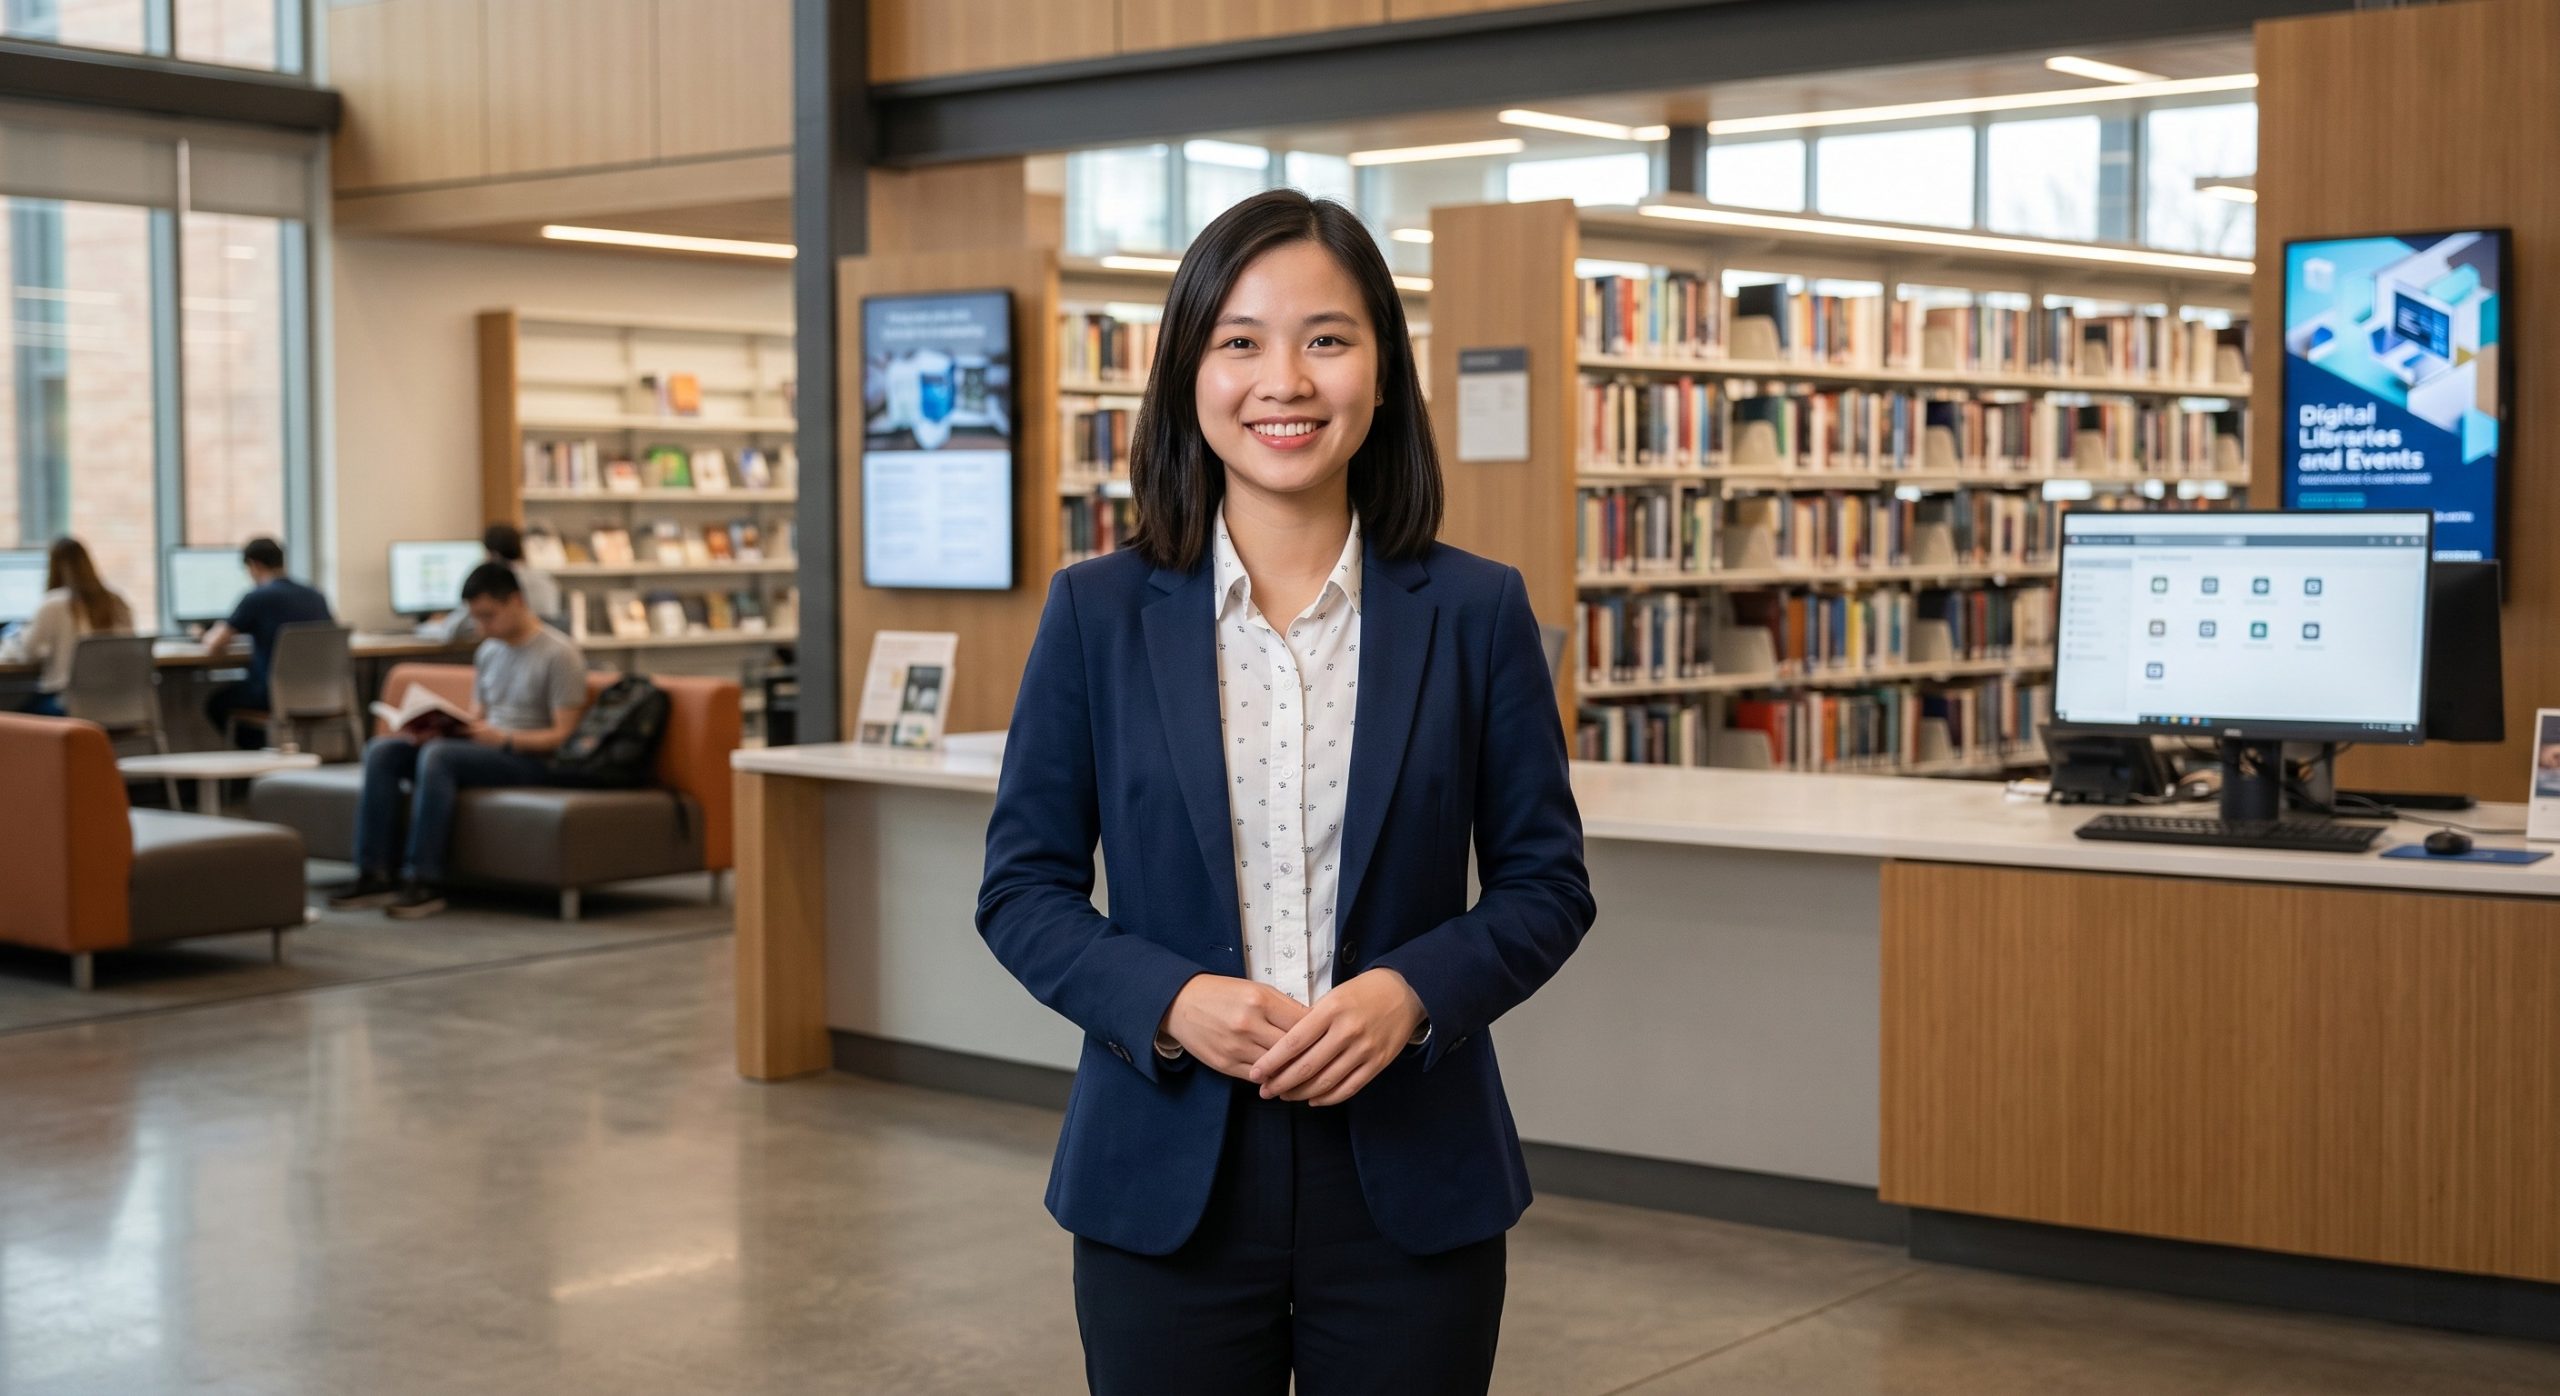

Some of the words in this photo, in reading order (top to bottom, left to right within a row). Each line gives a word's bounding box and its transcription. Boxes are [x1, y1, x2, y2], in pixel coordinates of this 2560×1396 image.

[2300, 402, 2376, 430] Digital
[2299, 426, 2402, 448] Libraries
[2299, 448, 2343, 471] and
[2346, 448, 2424, 470] Events
